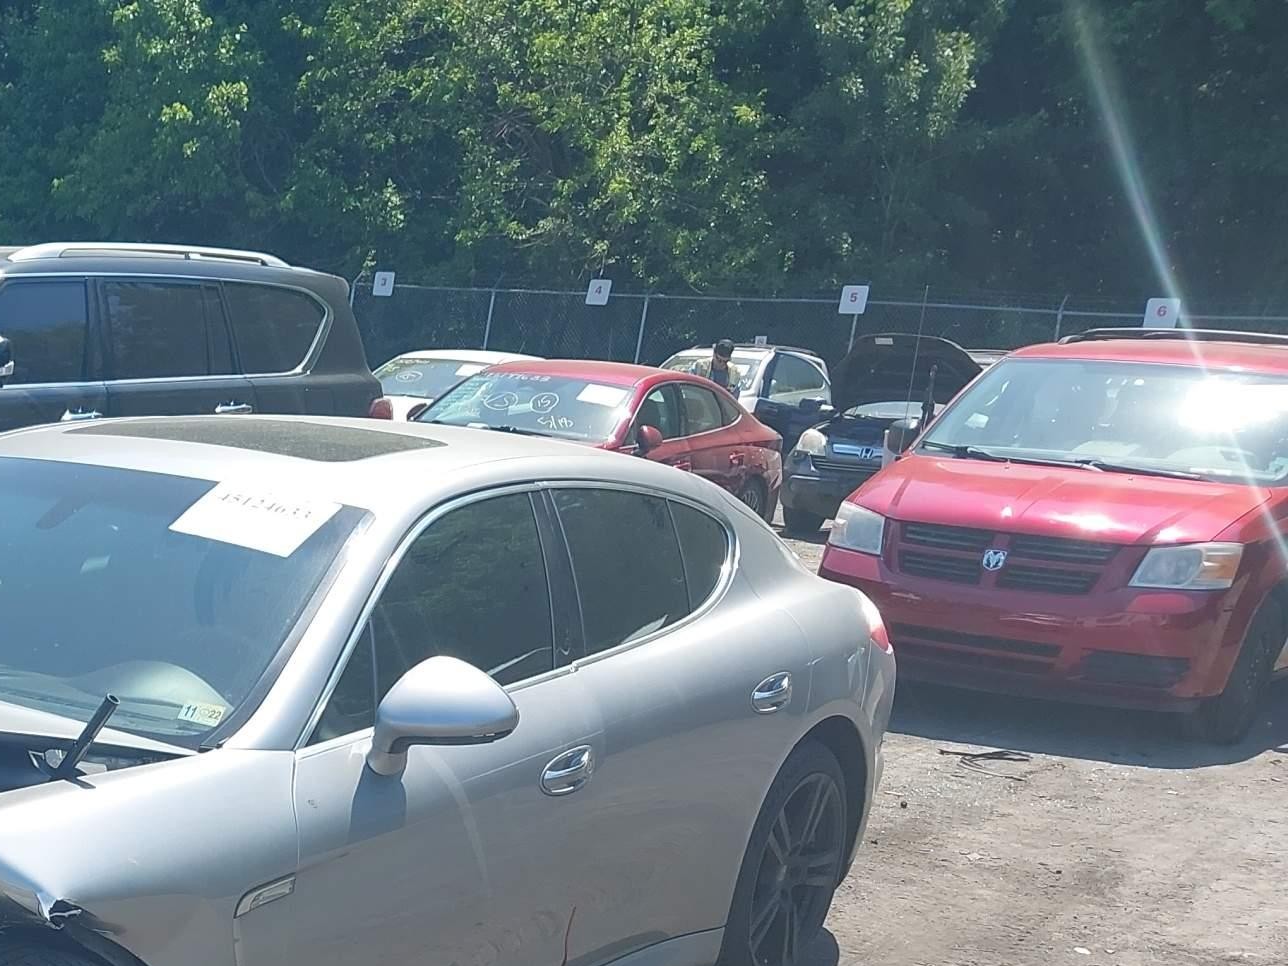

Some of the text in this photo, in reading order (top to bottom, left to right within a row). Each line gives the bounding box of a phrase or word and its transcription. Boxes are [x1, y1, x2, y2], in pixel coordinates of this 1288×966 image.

[594, 285, 602, 295] 4
[849, 291, 858, 303] 5
[1156, 305, 1168, 317] 6
[183, 704, 198, 718] 11
[207, 709, 223, 720] 22
